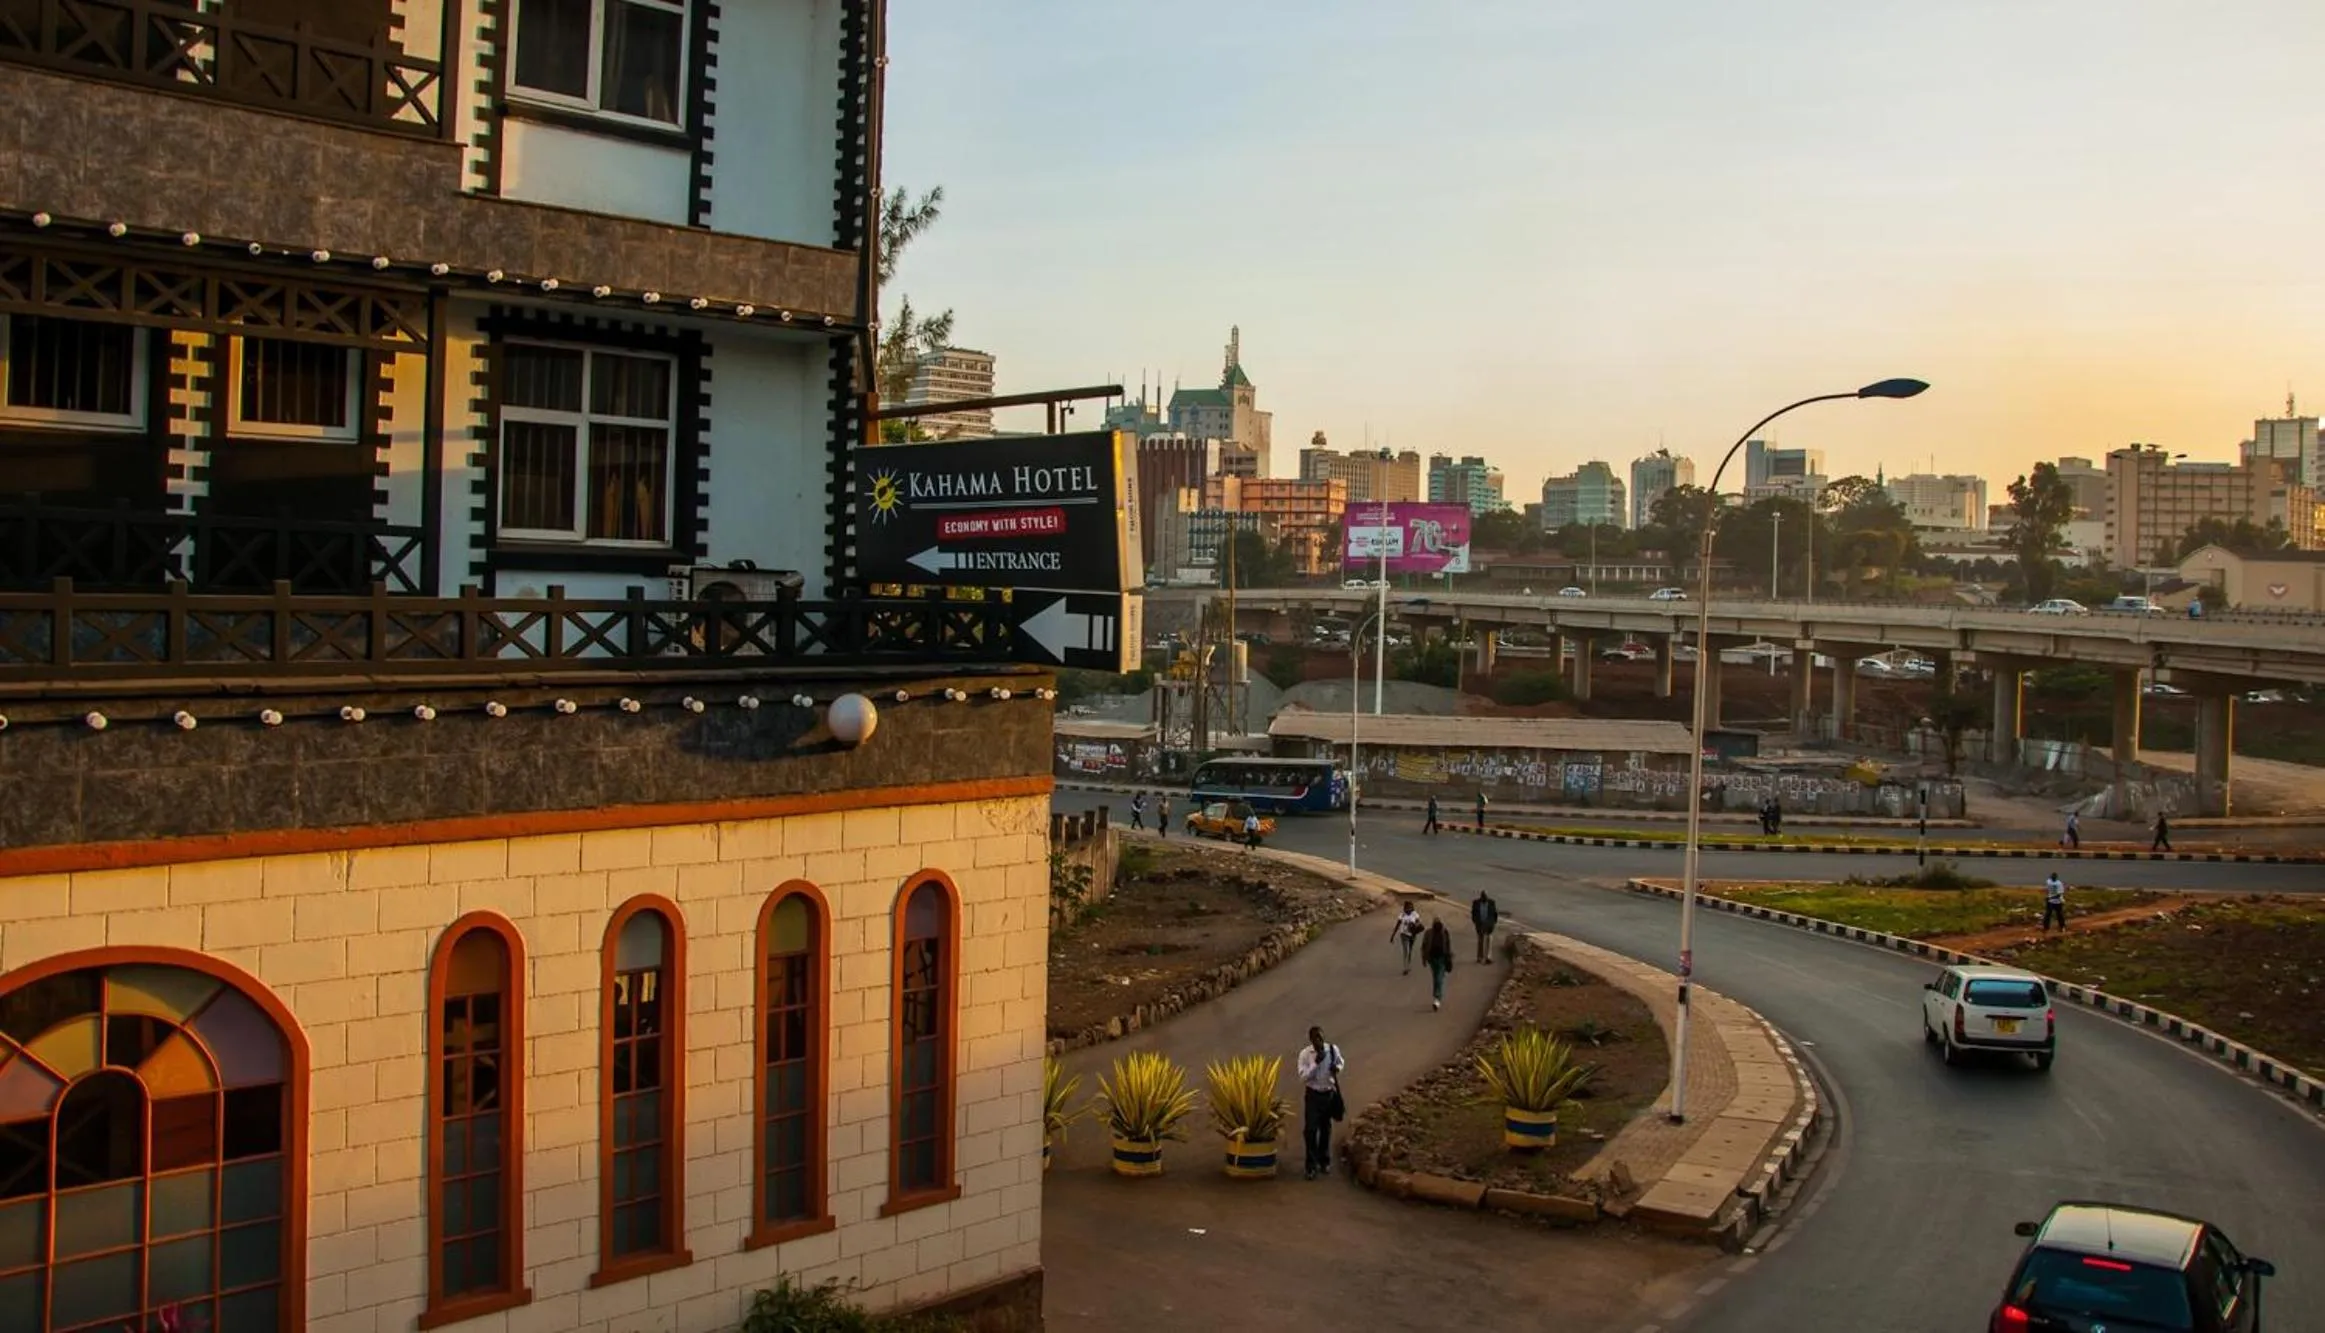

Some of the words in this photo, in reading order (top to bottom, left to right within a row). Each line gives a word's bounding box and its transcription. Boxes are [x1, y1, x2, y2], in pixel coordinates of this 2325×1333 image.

[909, 471, 1004, 497] KAHAMA
[1012, 465, 1099, 493] HOTEL
[944, 519, 990, 534] ECONOMY
[991, 517, 1018, 532] WITH
[1020, 515, 1059, 530] STYLE!
[976, 552, 1062, 571] ENTRANCE
